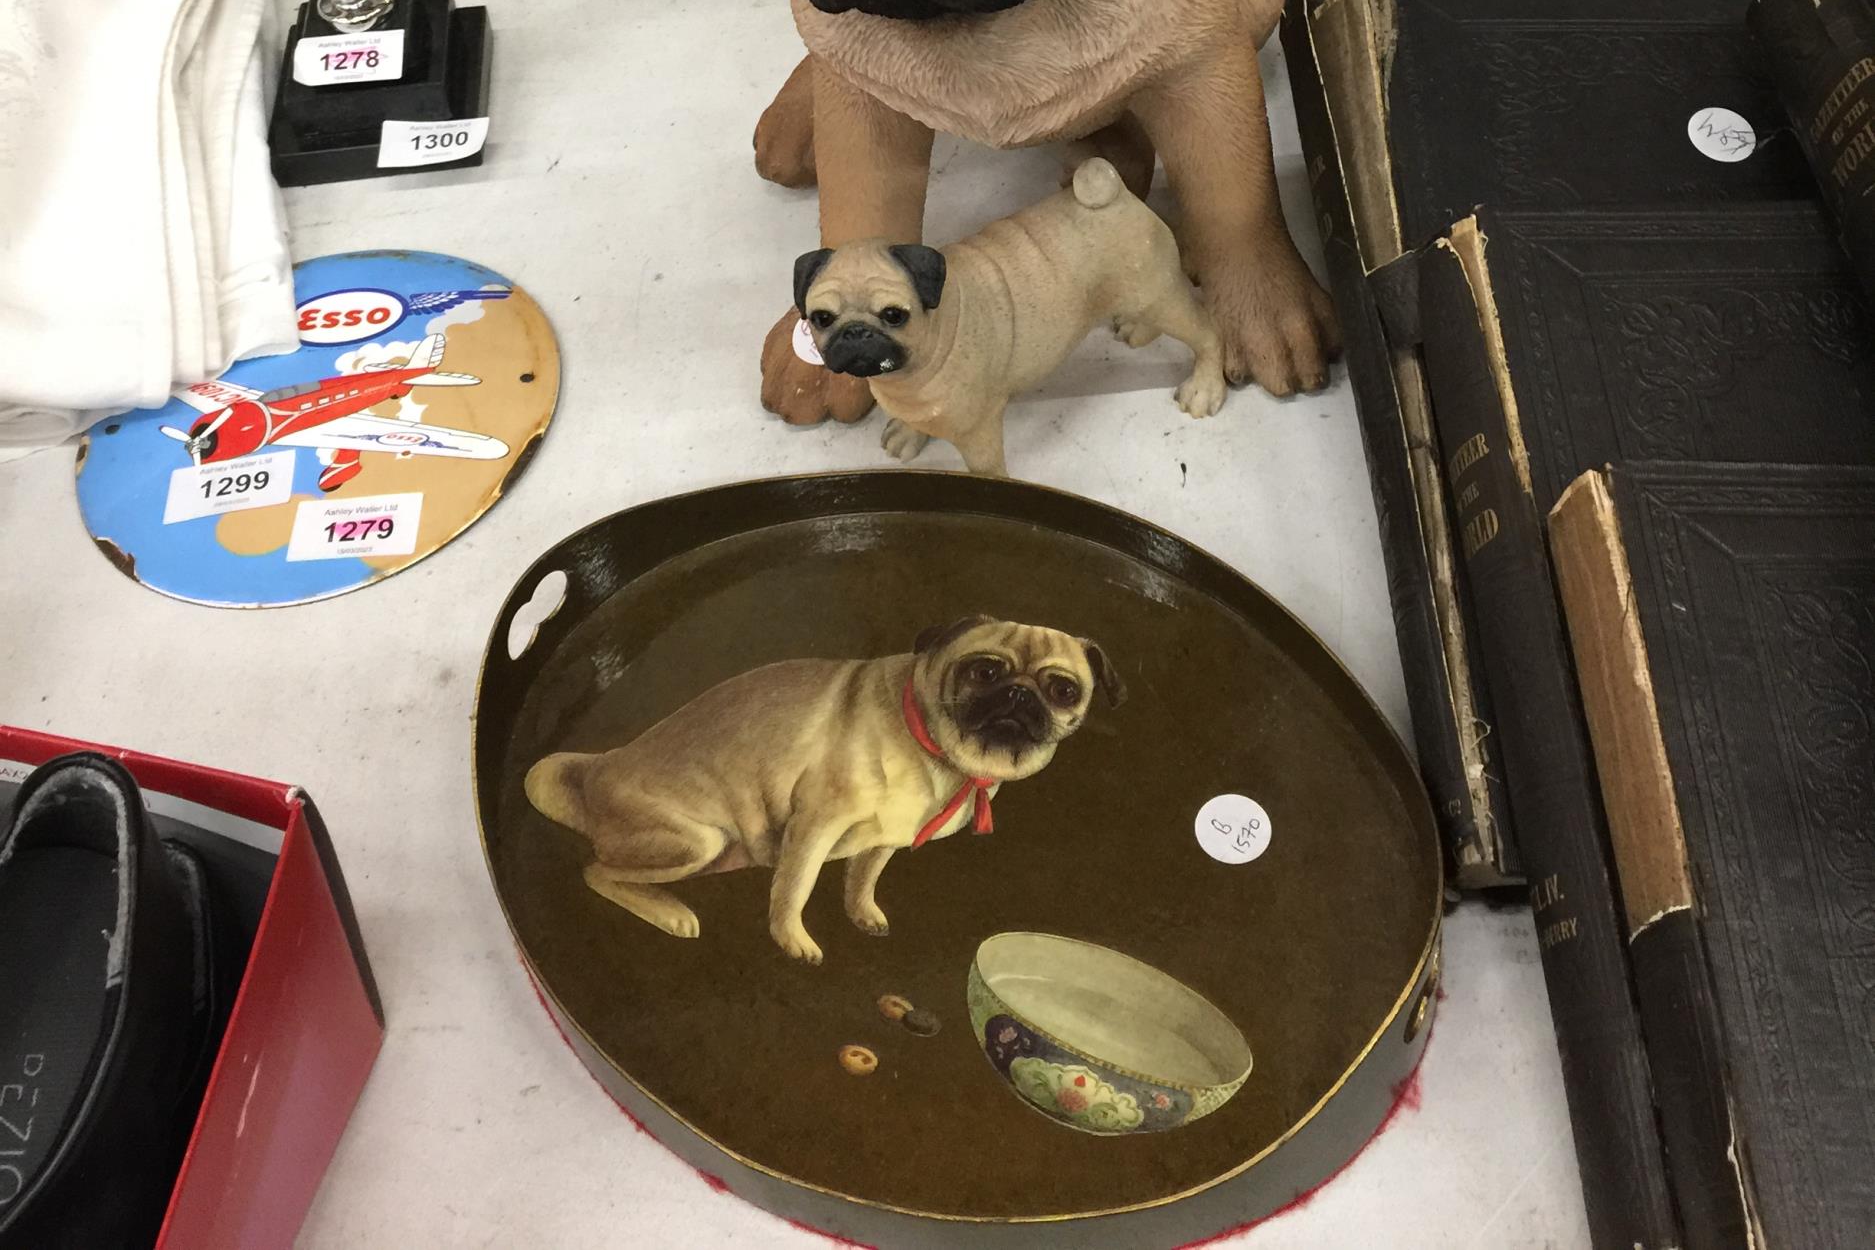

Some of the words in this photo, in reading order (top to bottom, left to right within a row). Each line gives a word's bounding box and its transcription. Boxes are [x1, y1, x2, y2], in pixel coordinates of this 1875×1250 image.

[320, 50, 379, 71] 1278
[411, 131, 469, 150] 1300
[297, 307, 391, 331] ESSO
[200, 471, 269, 499] 1299
[324, 507, 354, 517] Ashley
[384, 503, 399, 511] Ltd
[324, 518, 394, 543] 1279
